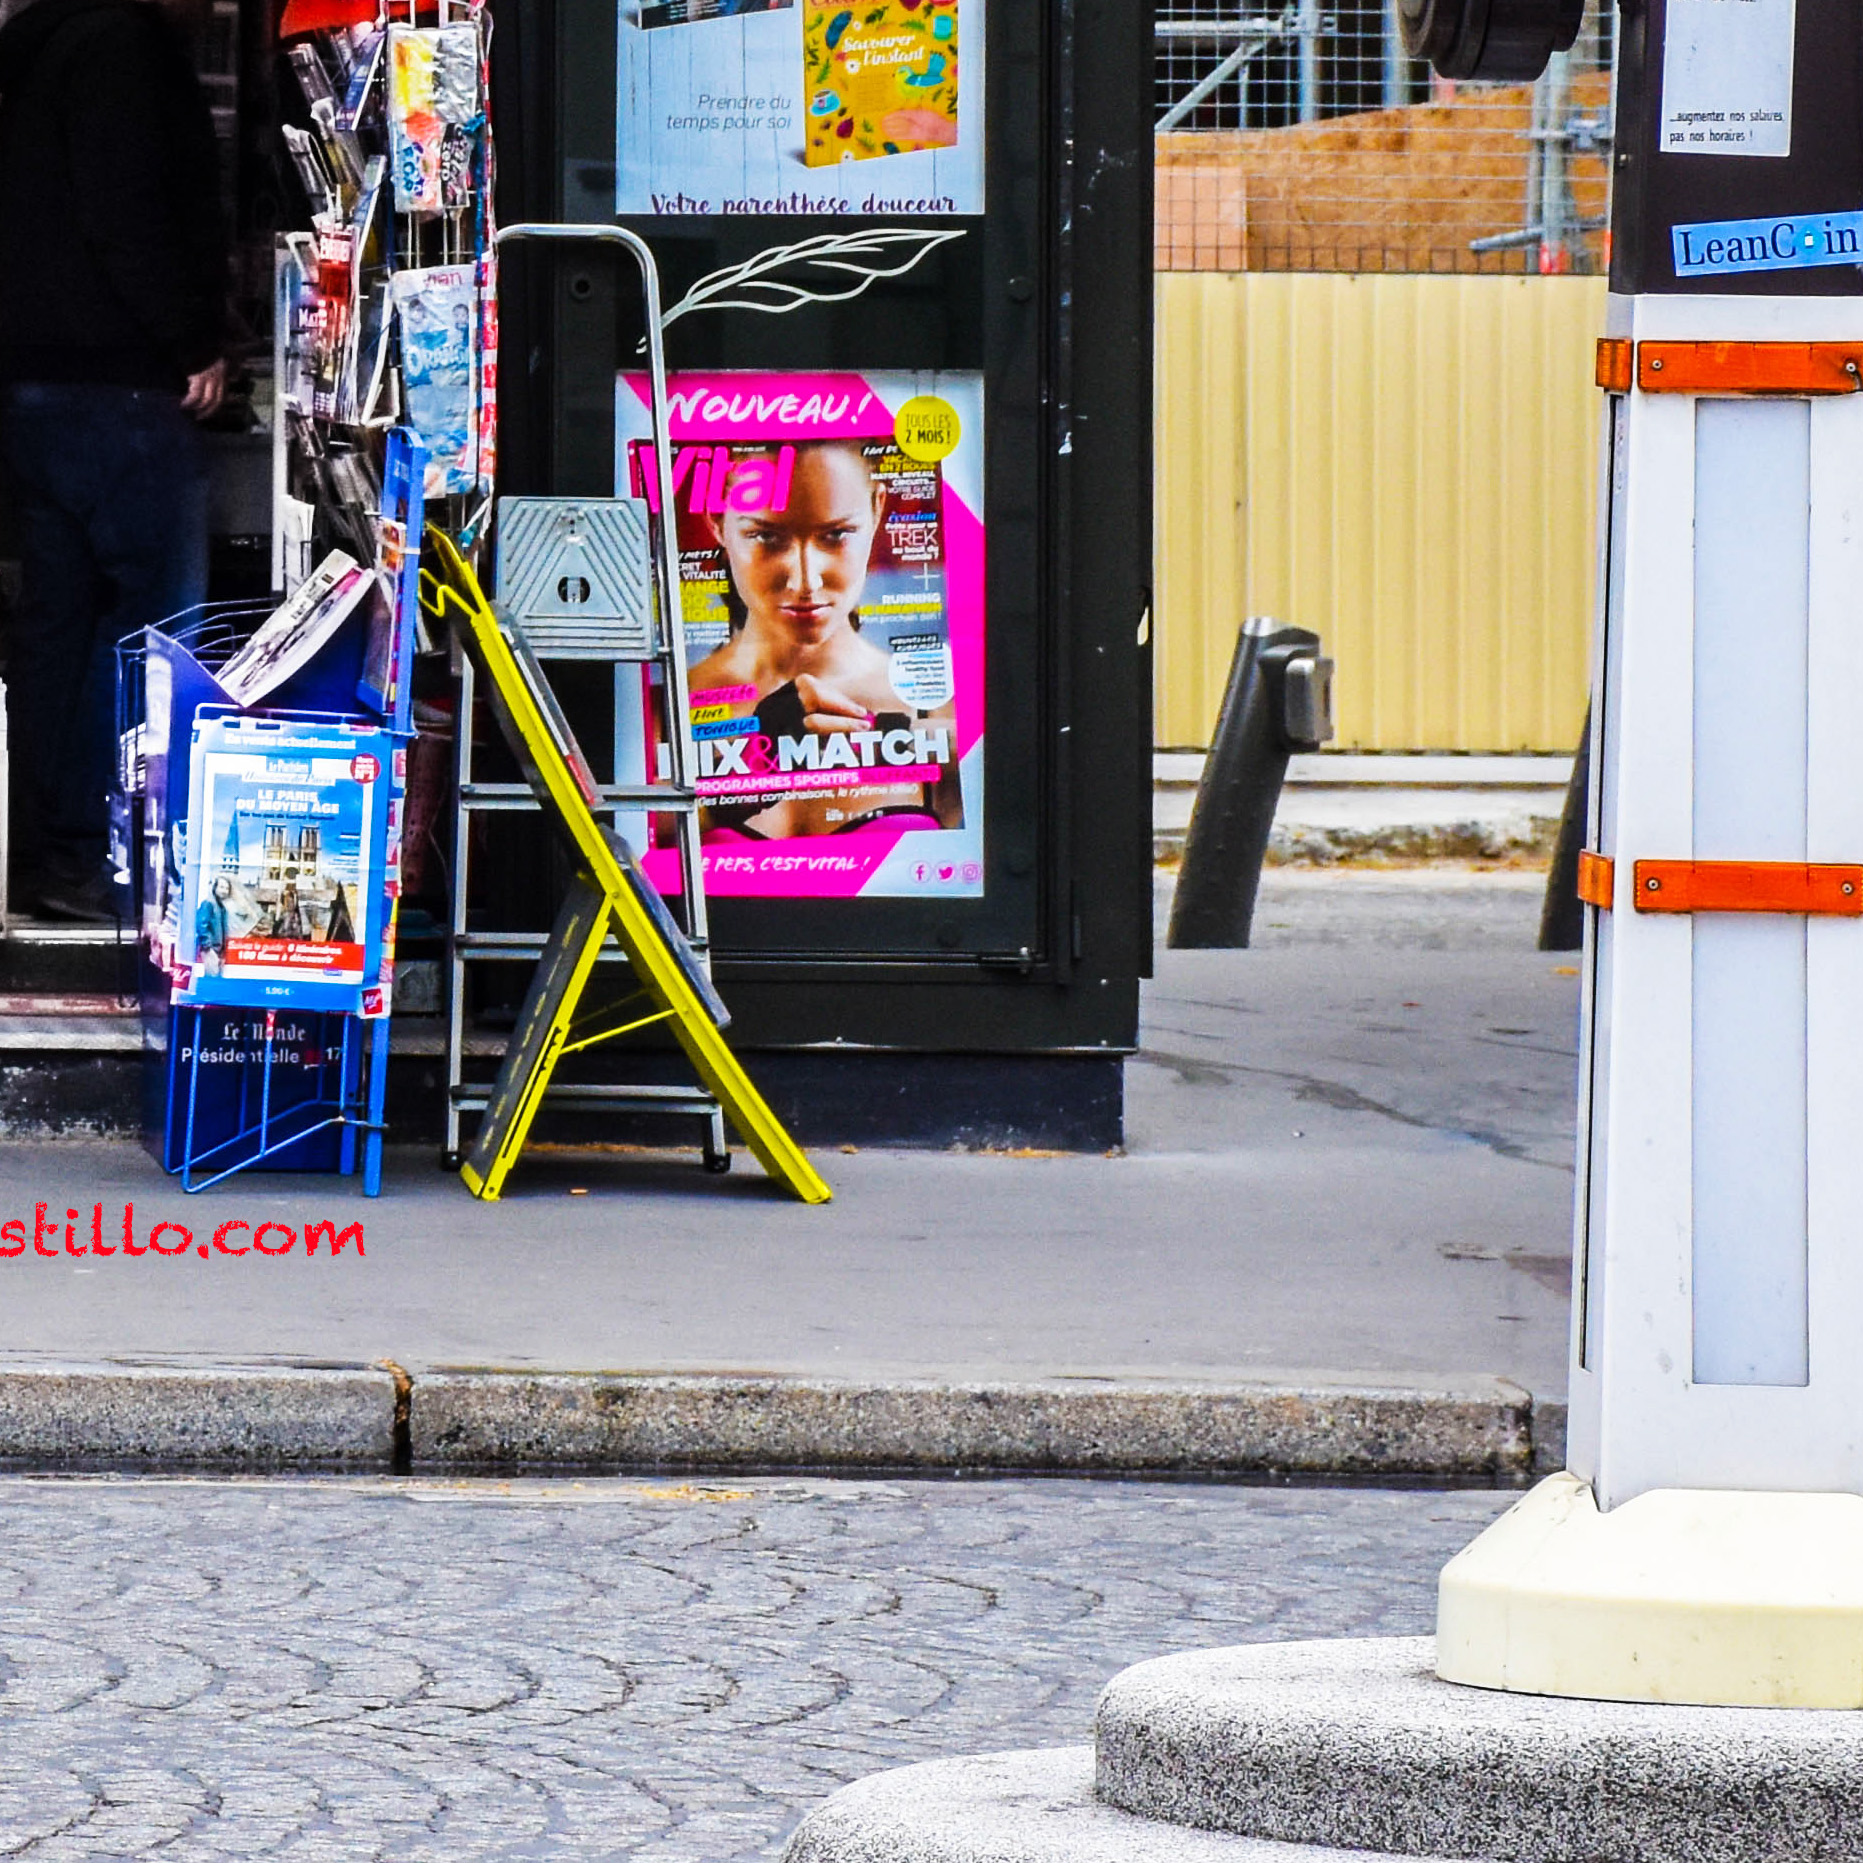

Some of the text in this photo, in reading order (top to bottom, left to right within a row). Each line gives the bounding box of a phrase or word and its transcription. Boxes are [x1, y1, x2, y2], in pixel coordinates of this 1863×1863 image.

[842, 34, 915, 53] Savourer
[863, 46, 925, 67] l'instant
[698, 94, 791, 111] Prendre du
[667, 114, 791, 131] temps pour soi
[1729, 112, 1745, 122] nos
[1669, 128, 1754, 145] pas nos horaires !
[651, 192, 958, 215] Votre parenthèse douceur
[667, 387, 871, 425] NOUVEAU !
[906, 413, 952, 429] TOUS LES
[905, 430, 951, 444] 2 MOIS !
[636, 443, 797, 515] Vital
[887, 528, 938, 547] TREK
[683, 569, 726, 580] VITALITÉ
[695, 719, 756, 735] TONIQUE
[696, 771, 859, 794] PROGRAMMES SPORTIFS
[258, 789, 318, 803] LE PARIS
[719, 785, 888, 805] bonnes combinaisons, le rythme
[236, 798, 308, 812] DU MOYEN
[715, 855, 871, 873] PEPS, C'EST VITAL !
[221, 1022, 306, 1042] Le Mnde
